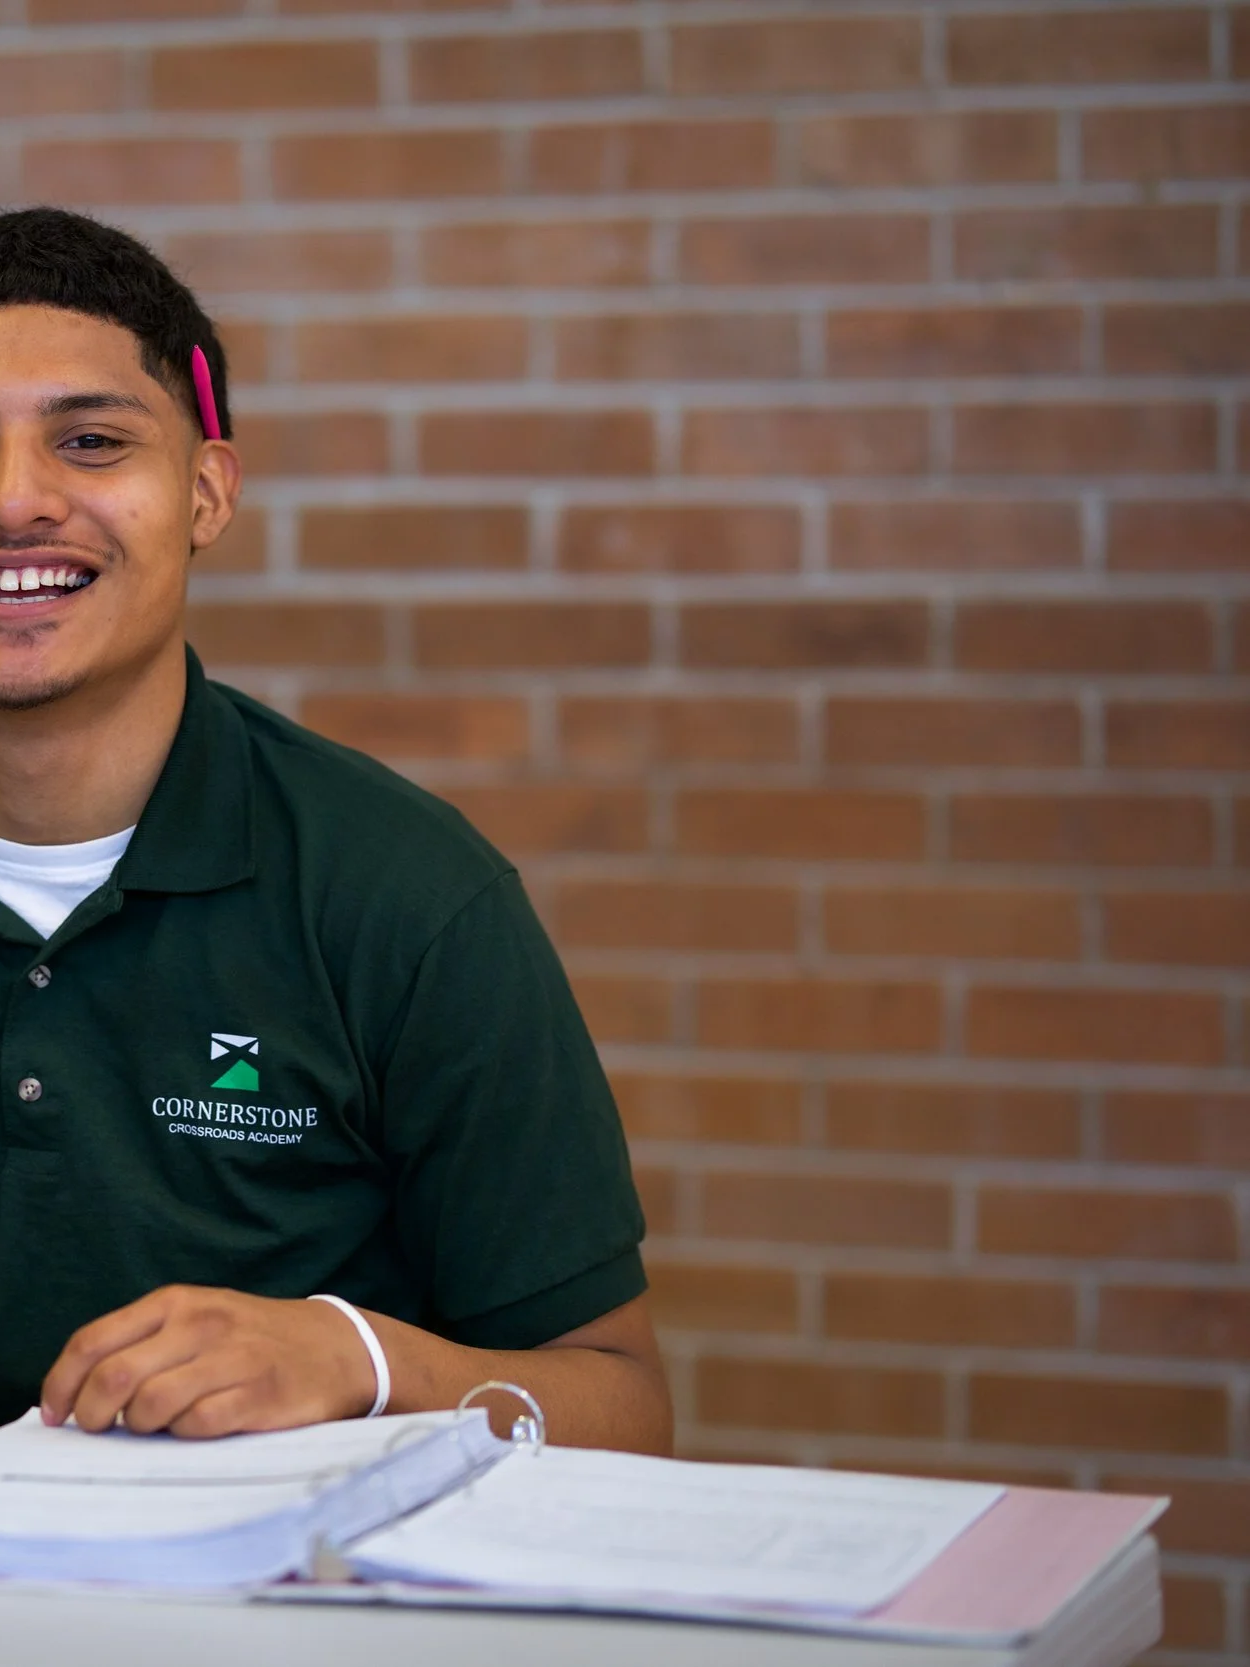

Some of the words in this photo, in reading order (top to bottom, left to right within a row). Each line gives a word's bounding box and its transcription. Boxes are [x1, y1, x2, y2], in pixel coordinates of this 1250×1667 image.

[152, 1097, 318, 1128] CORNERSTONE
[168, 1123, 245, 1141] CROSSROADS
[247, 1132, 302, 1145] ACADEMY
